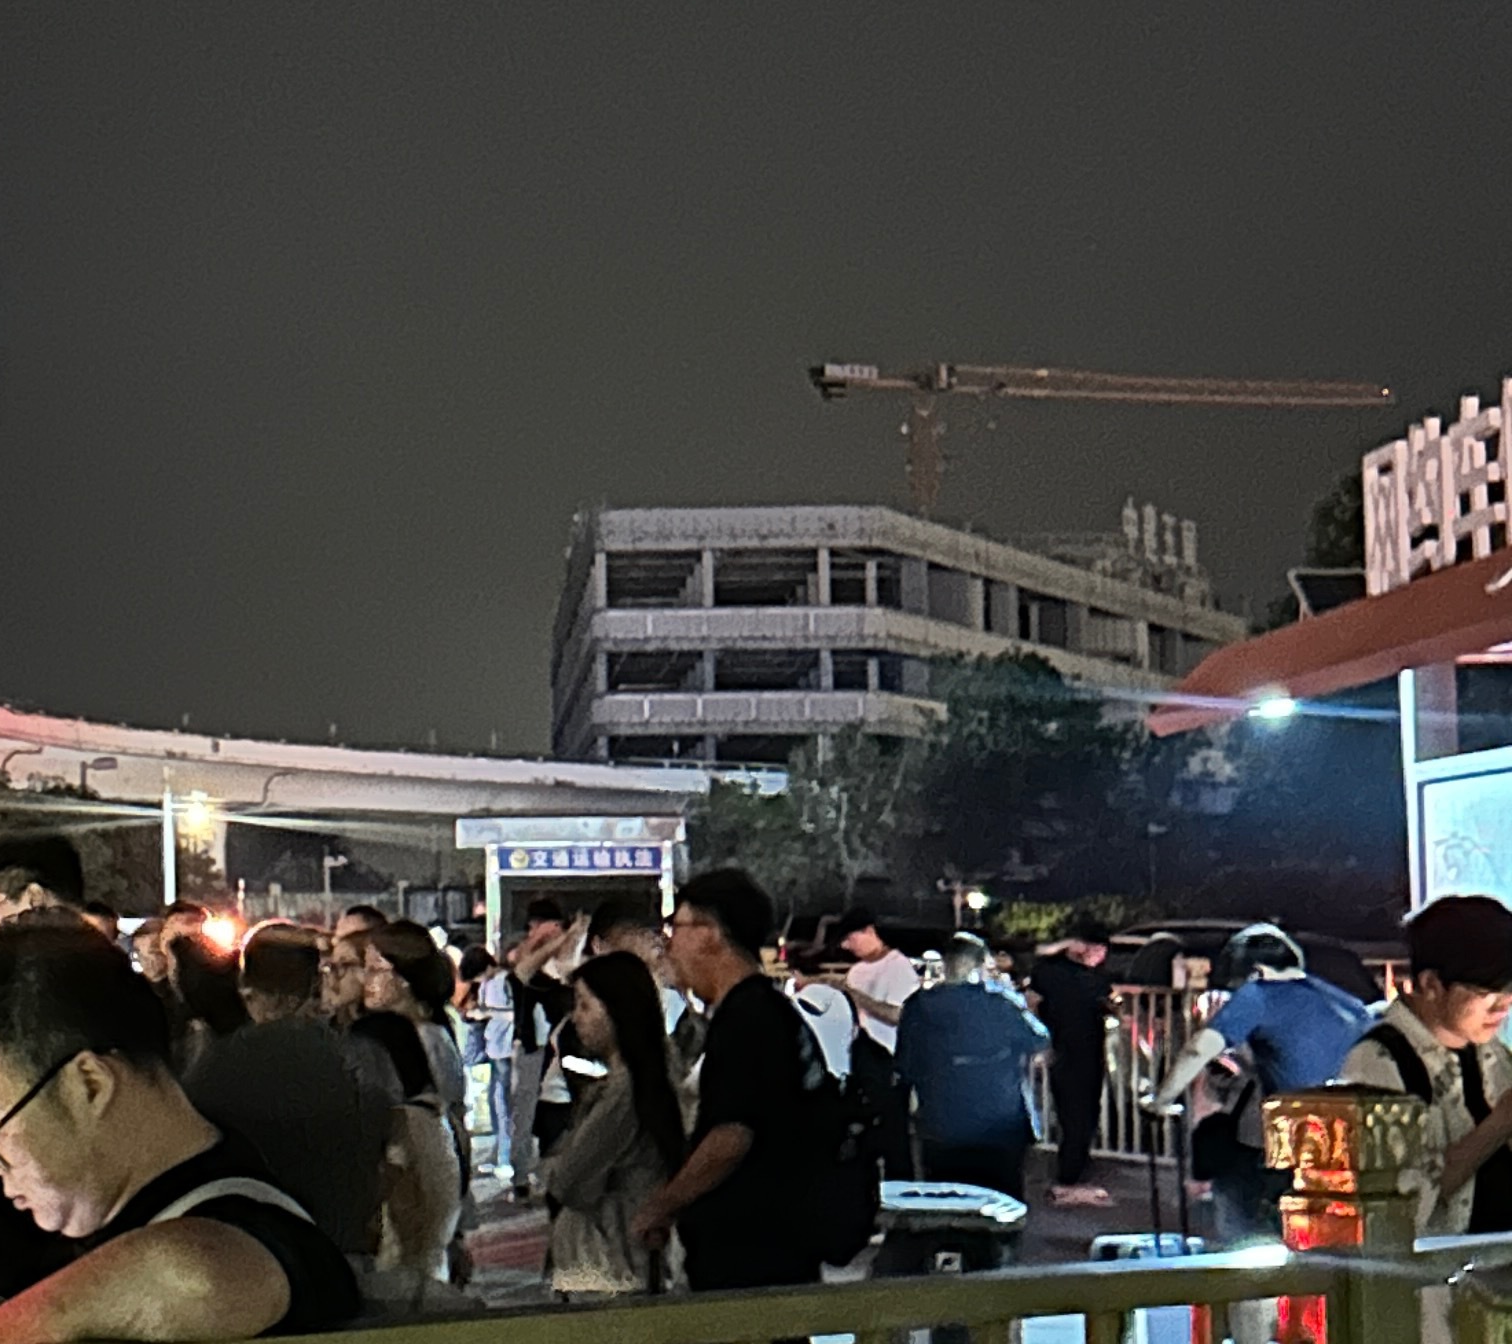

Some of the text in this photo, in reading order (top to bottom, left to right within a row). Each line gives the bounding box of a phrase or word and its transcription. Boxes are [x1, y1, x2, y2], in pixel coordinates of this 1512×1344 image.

[1362, 377, 1512, 597] 网约车
[531, 848, 653, 868] 交通运输执法
